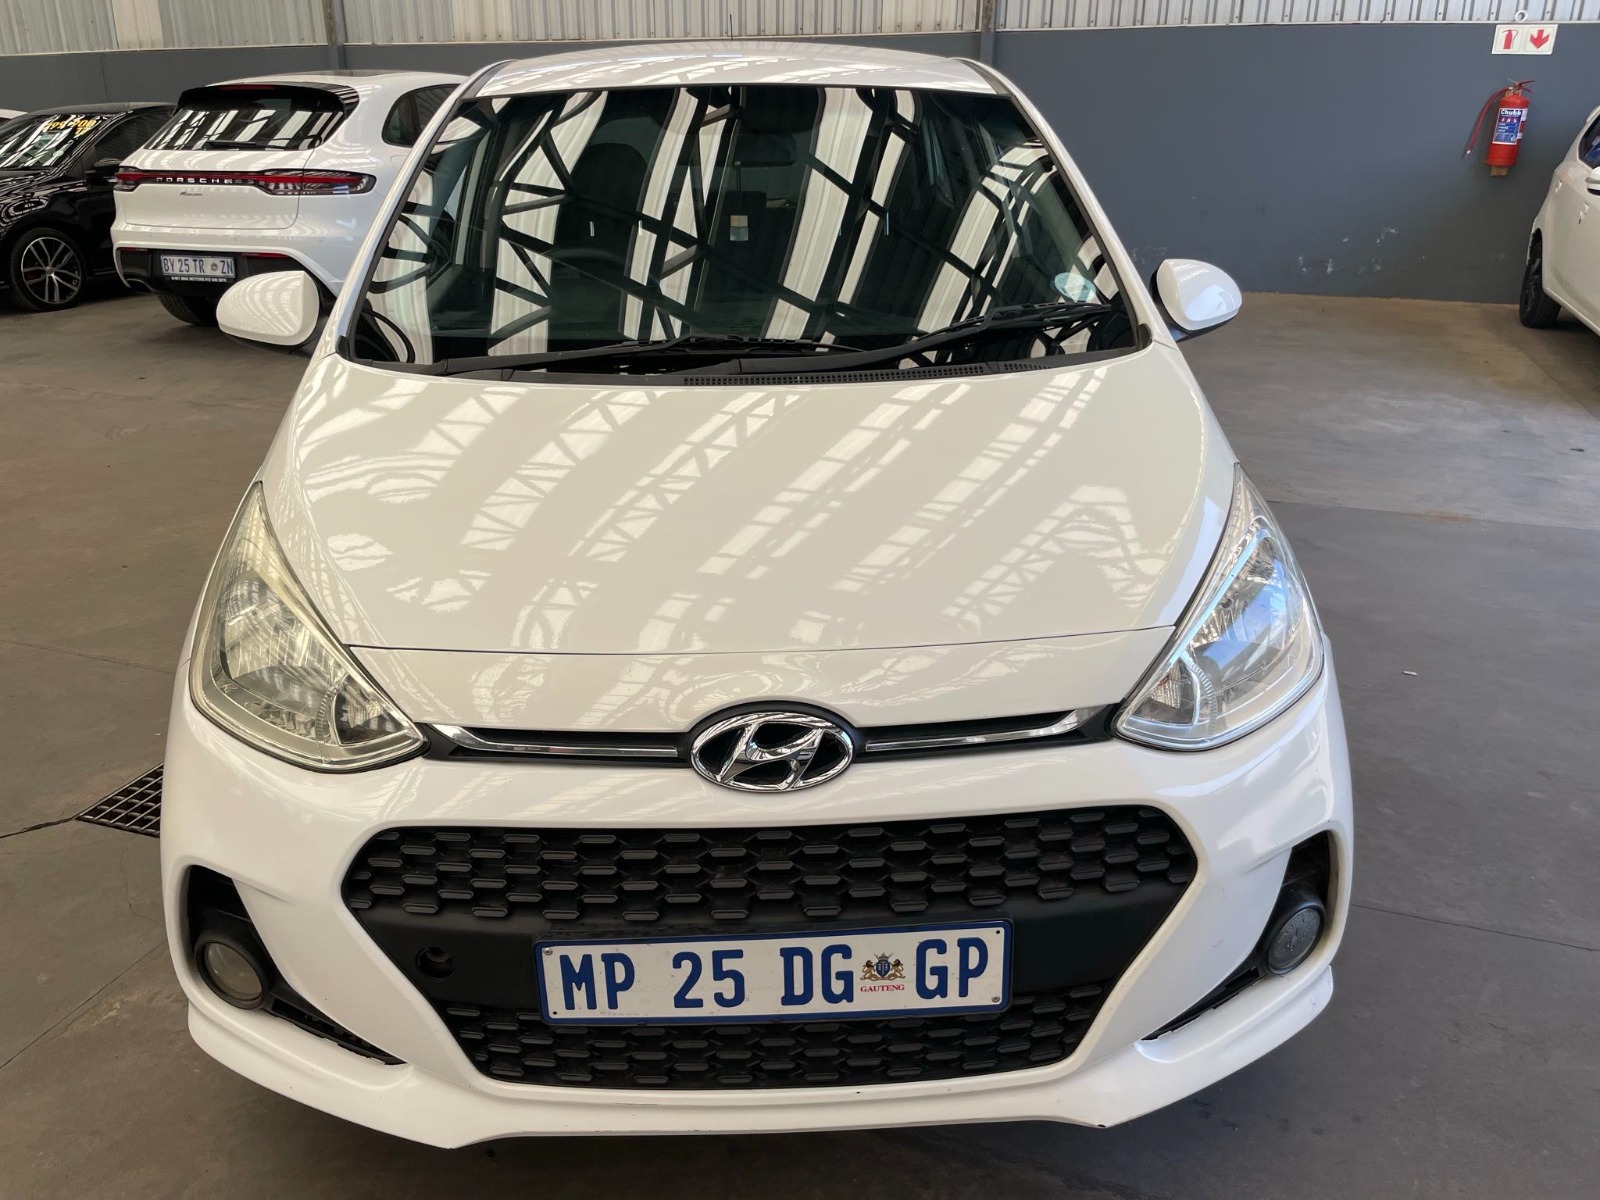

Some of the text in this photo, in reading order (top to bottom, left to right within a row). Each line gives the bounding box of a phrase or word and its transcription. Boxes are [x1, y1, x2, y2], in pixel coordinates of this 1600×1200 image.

[163, 258, 234, 275] BY 25 TR ZN
[559, 937, 989, 1010] MP 25 DG GP
[860, 984, 905, 993] GAUTENG
